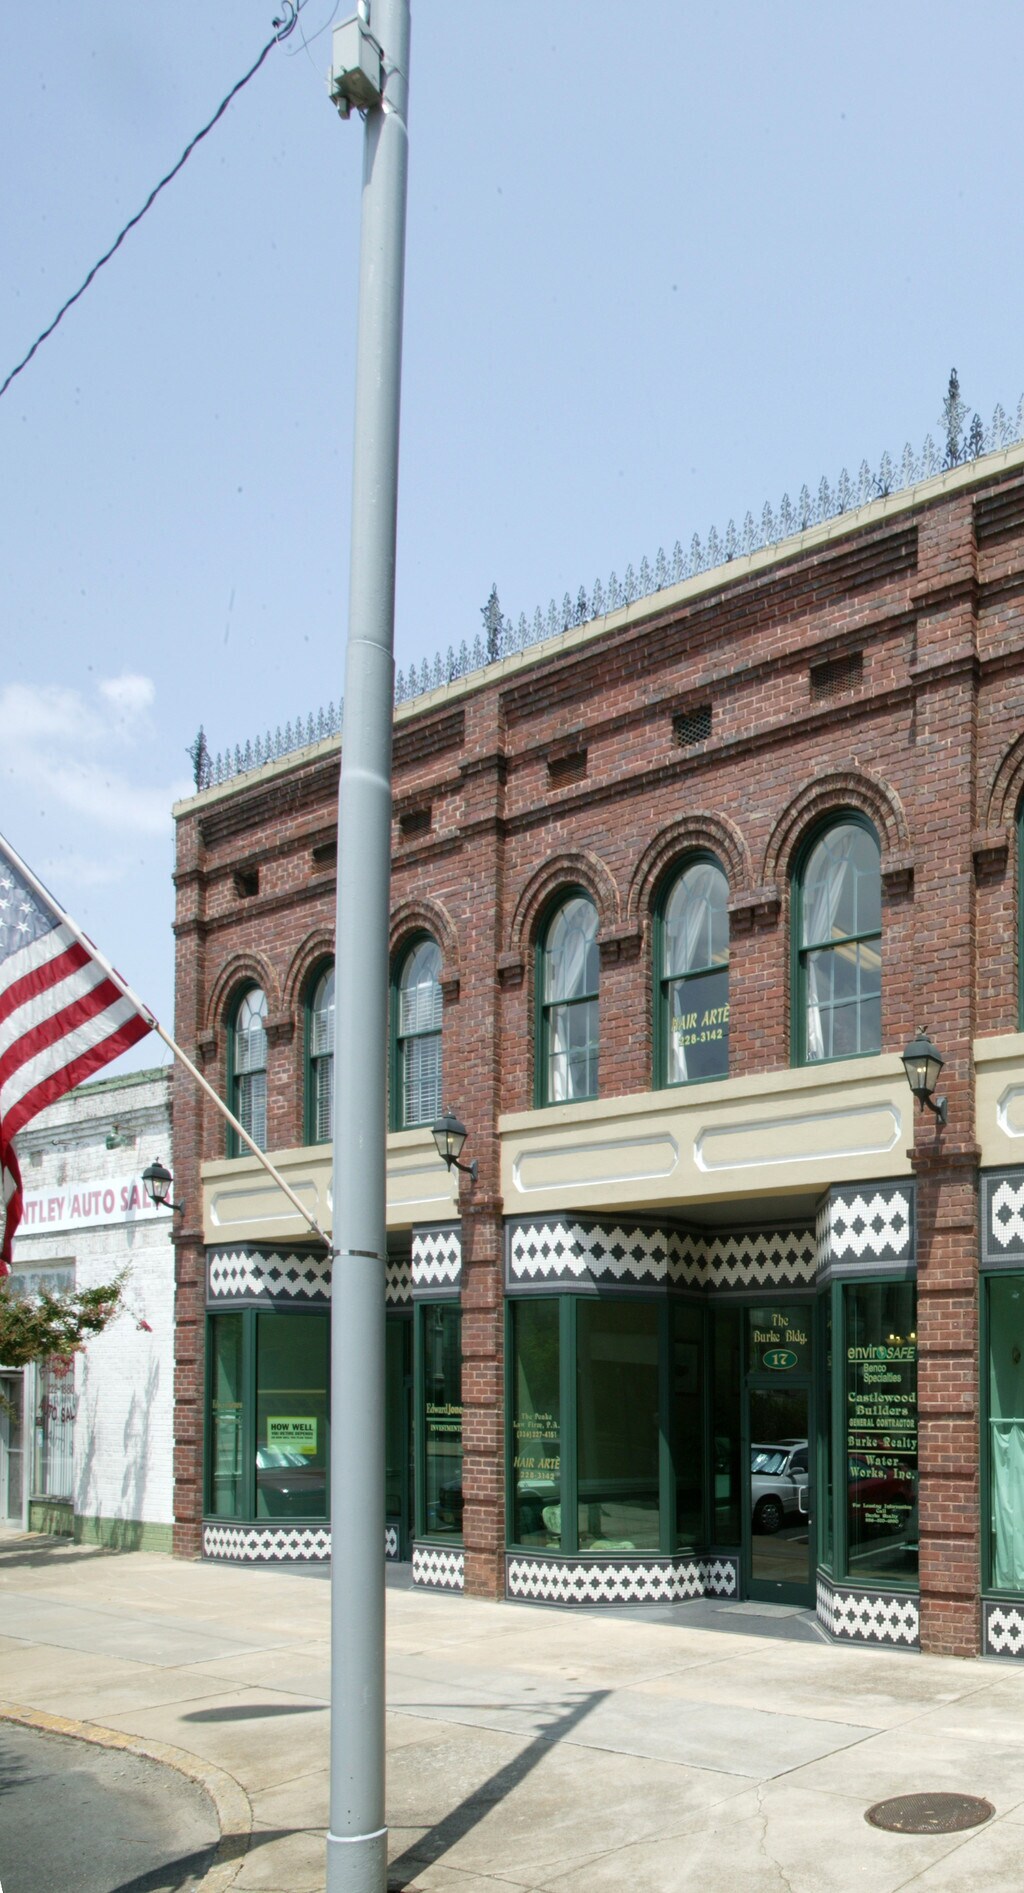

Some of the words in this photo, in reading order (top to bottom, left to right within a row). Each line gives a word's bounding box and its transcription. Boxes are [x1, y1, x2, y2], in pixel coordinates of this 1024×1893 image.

[671, 1012, 698, 1033] HAIR
[678, 1028, 723, 1047] 228-3142
[70, 1189, 115, 1218] AUTO
[771, 1313, 789, 1328] The
[754, 1330, 780, 1342] Burke
[786, 1329, 808, 1345] Bldg.
[772, 1353, 788, 1365] 17
[863, 1363, 887, 1372] Benco
[863, 1373, 902, 1384] Specialties
[848, 1392, 916, 1402] Castlewood
[855, 1405, 909, 1416] Builders
[271, 1423, 290, 1431] HOW
[292, 1423, 314, 1431] WELL
[849, 1419, 874, 1427] GENERAL
[876, 1419, 915, 1428] CONTRACTOR
[847, 1436, 878, 1447] Burke
[883, 1437, 917, 1450] Realty
[513, 1457, 534, 1468] HAIR
[865, 1455, 899, 1466] Water
[850, 1466, 887, 1480] Works,
[893, 1469, 915, 1481] Inc.
